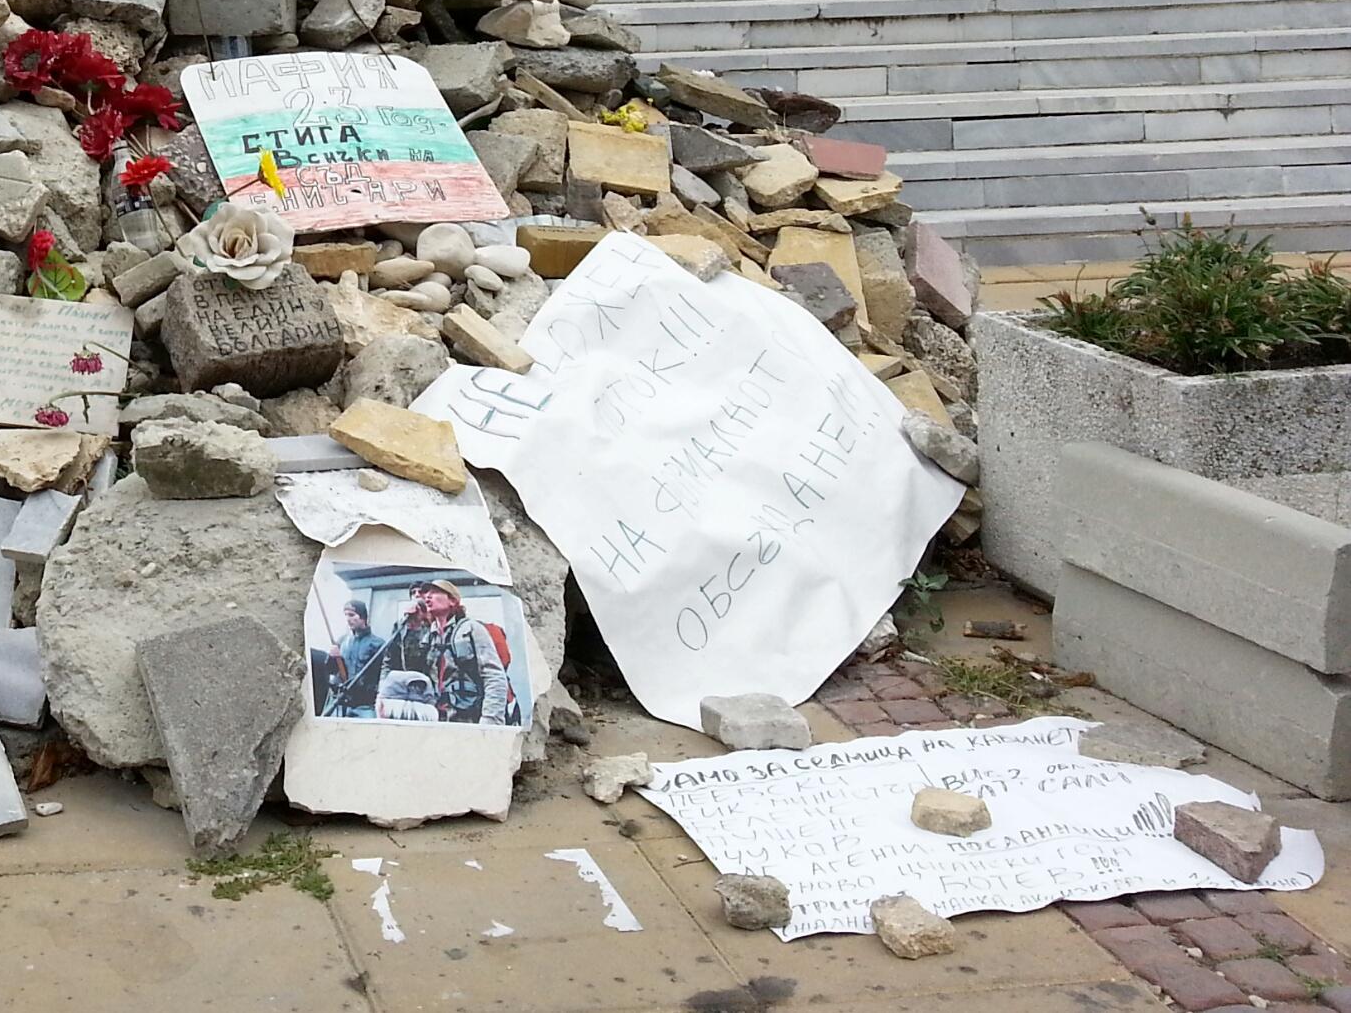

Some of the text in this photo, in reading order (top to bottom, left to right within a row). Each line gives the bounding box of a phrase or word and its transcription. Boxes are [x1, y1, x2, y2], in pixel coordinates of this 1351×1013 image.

[199, 52, 398, 100] МАФИЯ
[284, 86, 367, 127] 23
[232, 298, 305, 321] ЕДИН
[216, 318, 341, 356] БЪЛГАРИН
[747, 762, 788, 780] ЗА
